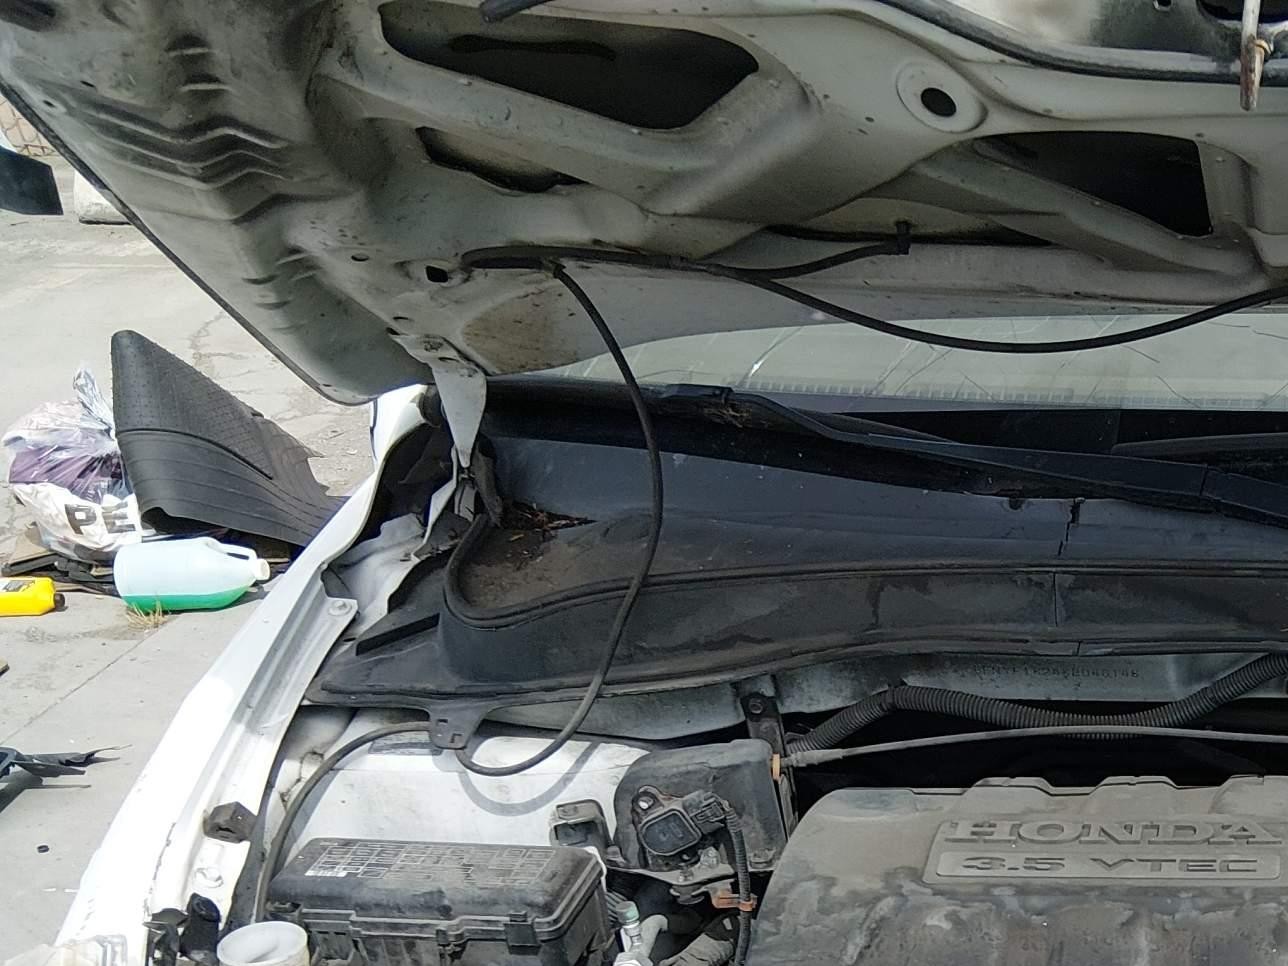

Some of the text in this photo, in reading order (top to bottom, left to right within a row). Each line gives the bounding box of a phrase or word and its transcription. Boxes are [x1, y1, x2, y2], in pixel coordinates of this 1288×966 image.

[944, 821, 1283, 846] HONDA
[961, 856, 1258, 873] 3.5 VTEC
